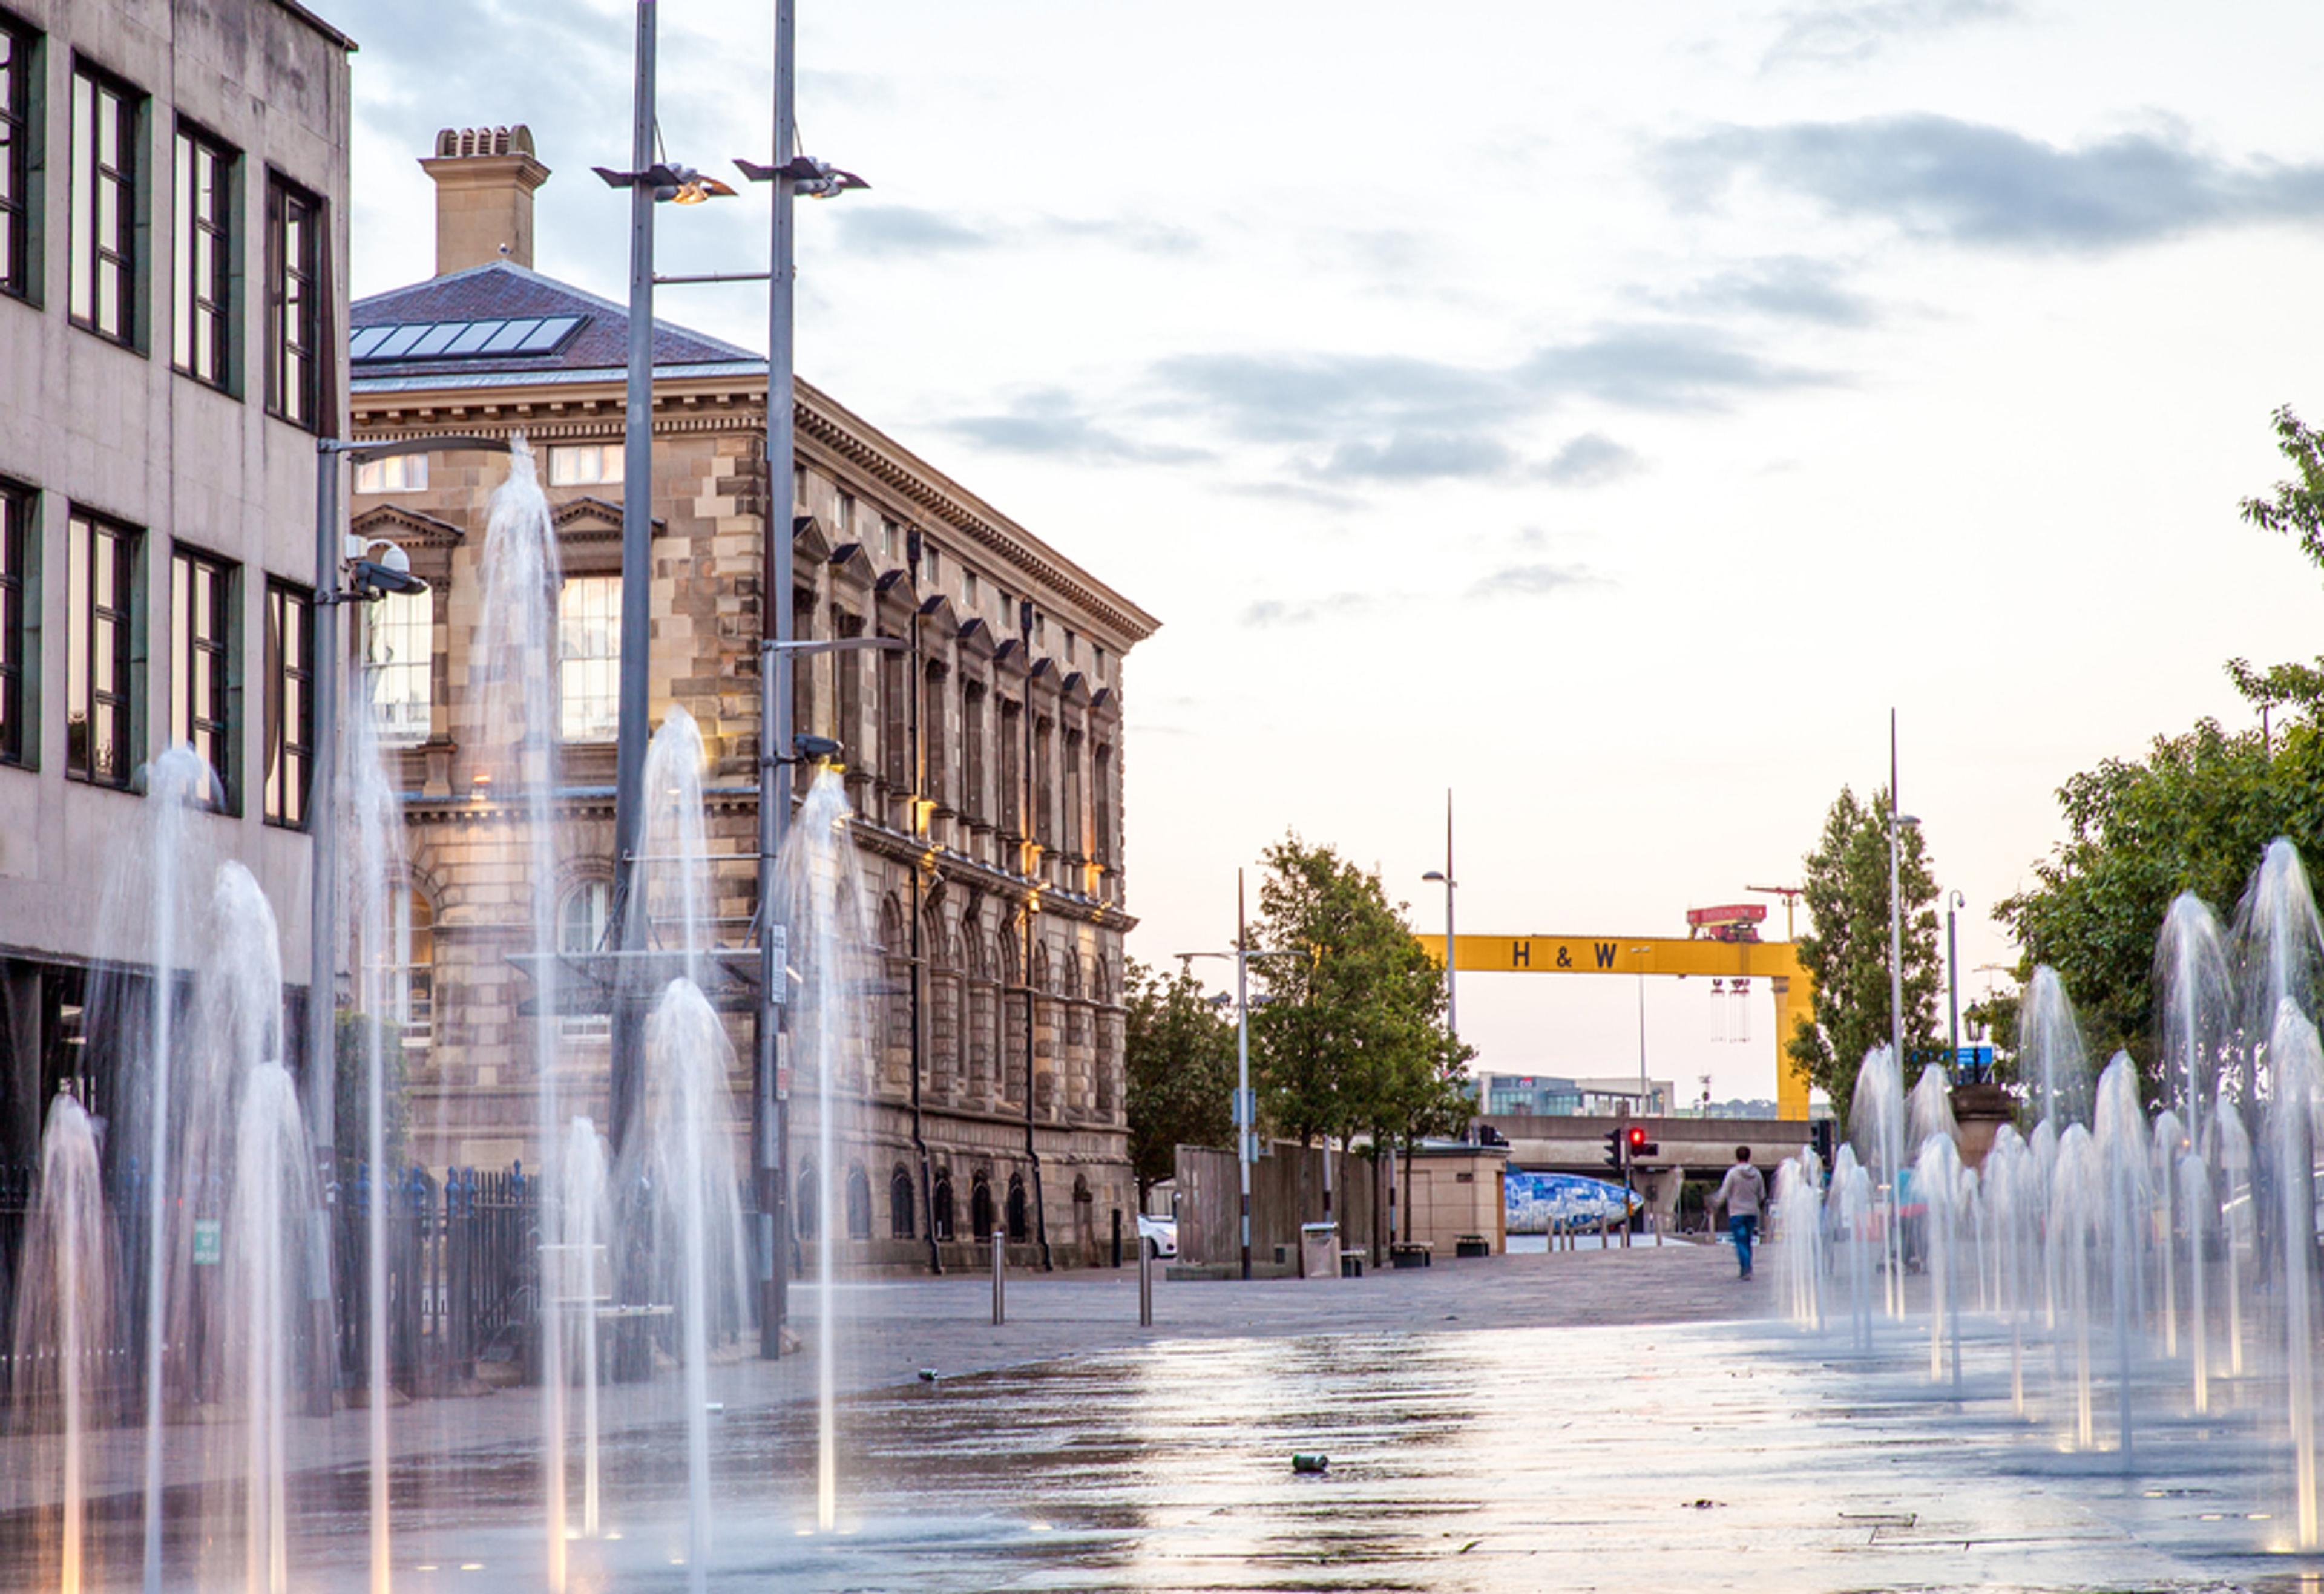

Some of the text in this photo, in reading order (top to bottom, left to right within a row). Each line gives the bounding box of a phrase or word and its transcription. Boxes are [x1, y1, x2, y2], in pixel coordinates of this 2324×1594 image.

[1514, 941, 1617, 969] H & W
